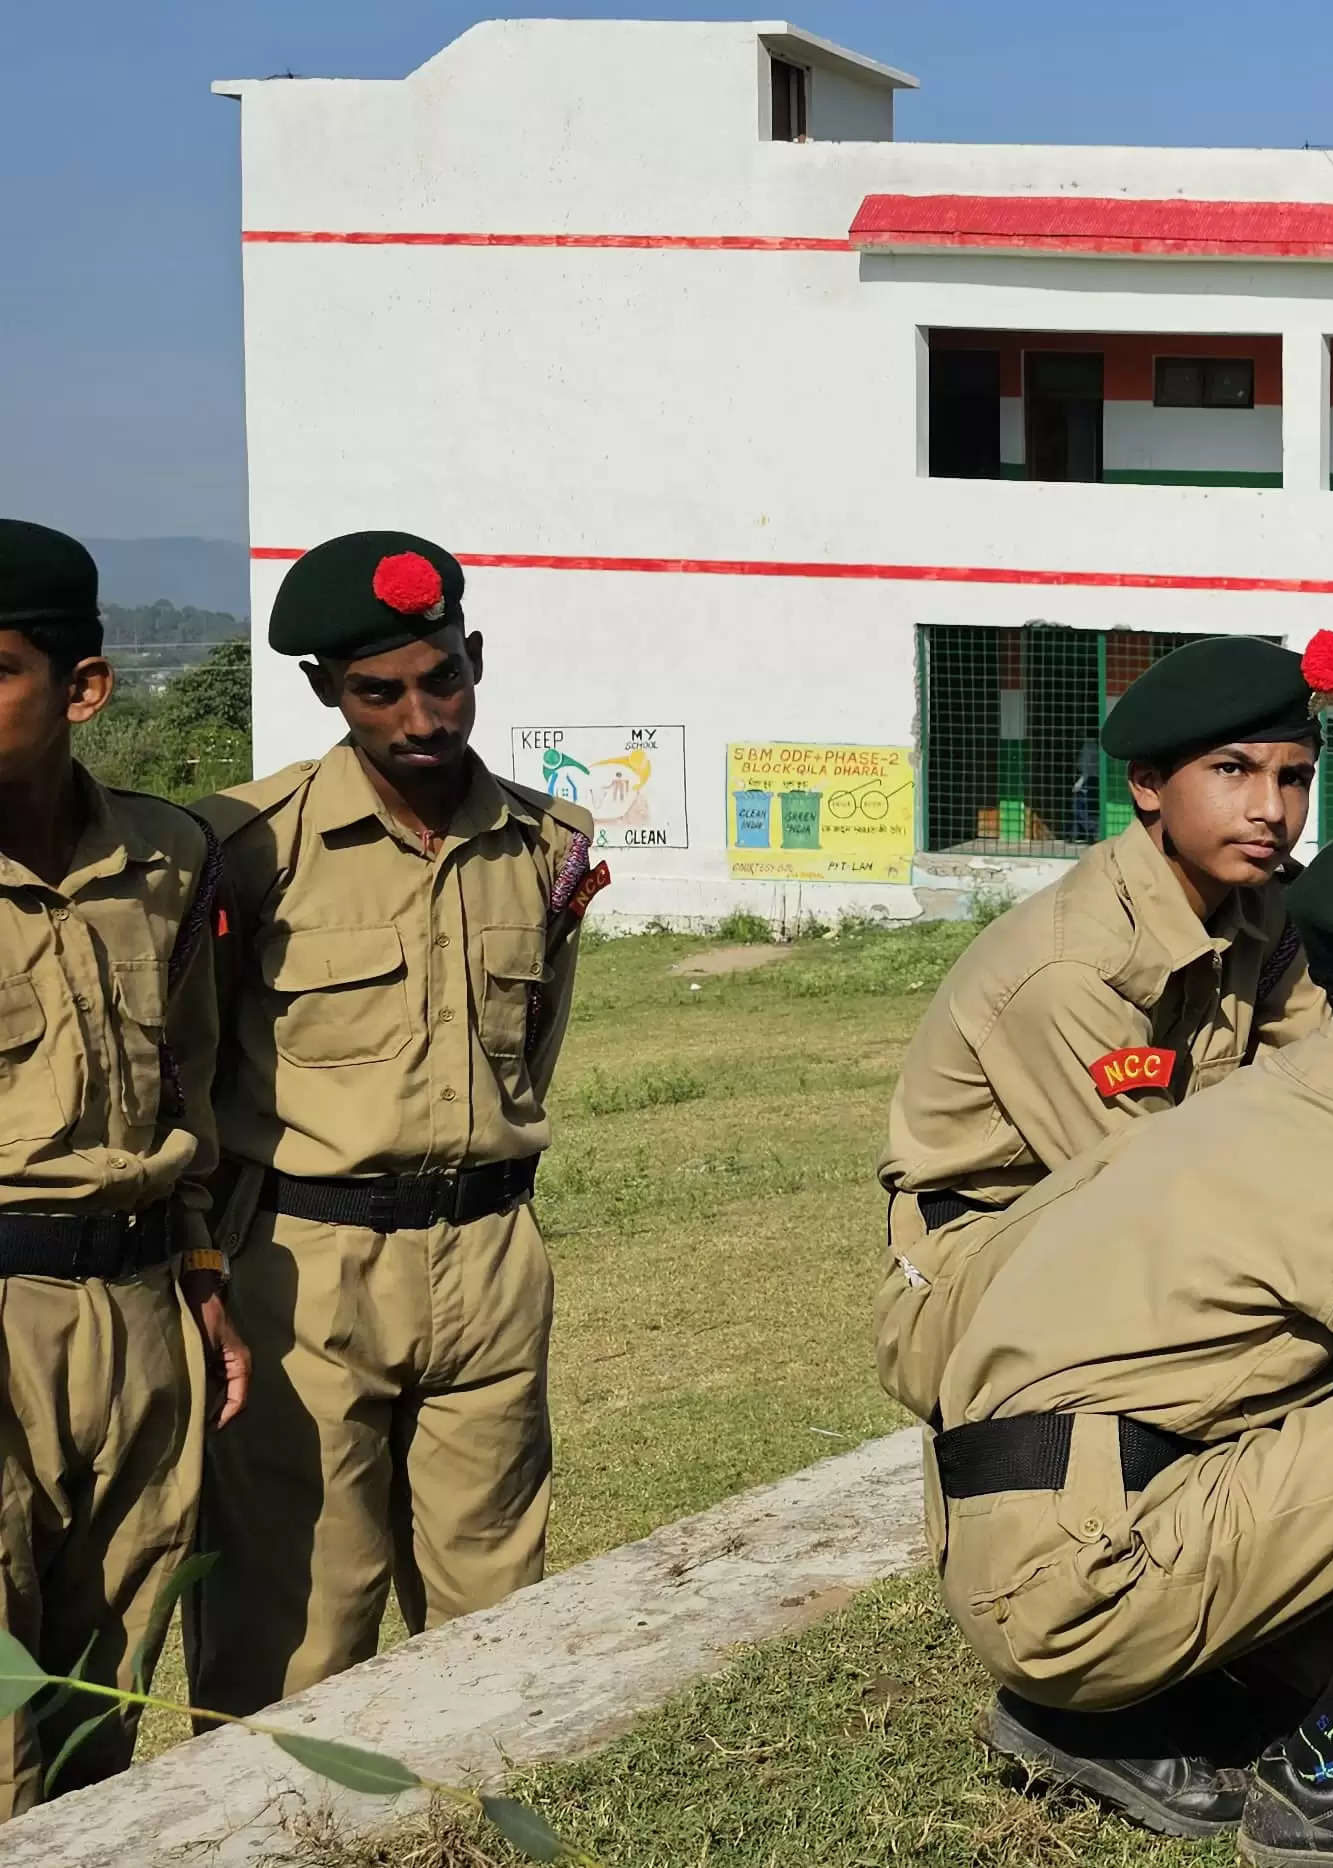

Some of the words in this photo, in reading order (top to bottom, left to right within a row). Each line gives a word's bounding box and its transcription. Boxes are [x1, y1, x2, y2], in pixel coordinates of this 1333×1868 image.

[522, 731, 564, 749] KEEP
[632, 729, 657, 740] MY
[733, 748, 773, 761] SBM
[834, 765, 889, 777] DHARAL
[625, 830, 666, 845] CLEAN
[576, 869, 606, 908] NCC
[1104, 1055, 1161, 1087] NCC
